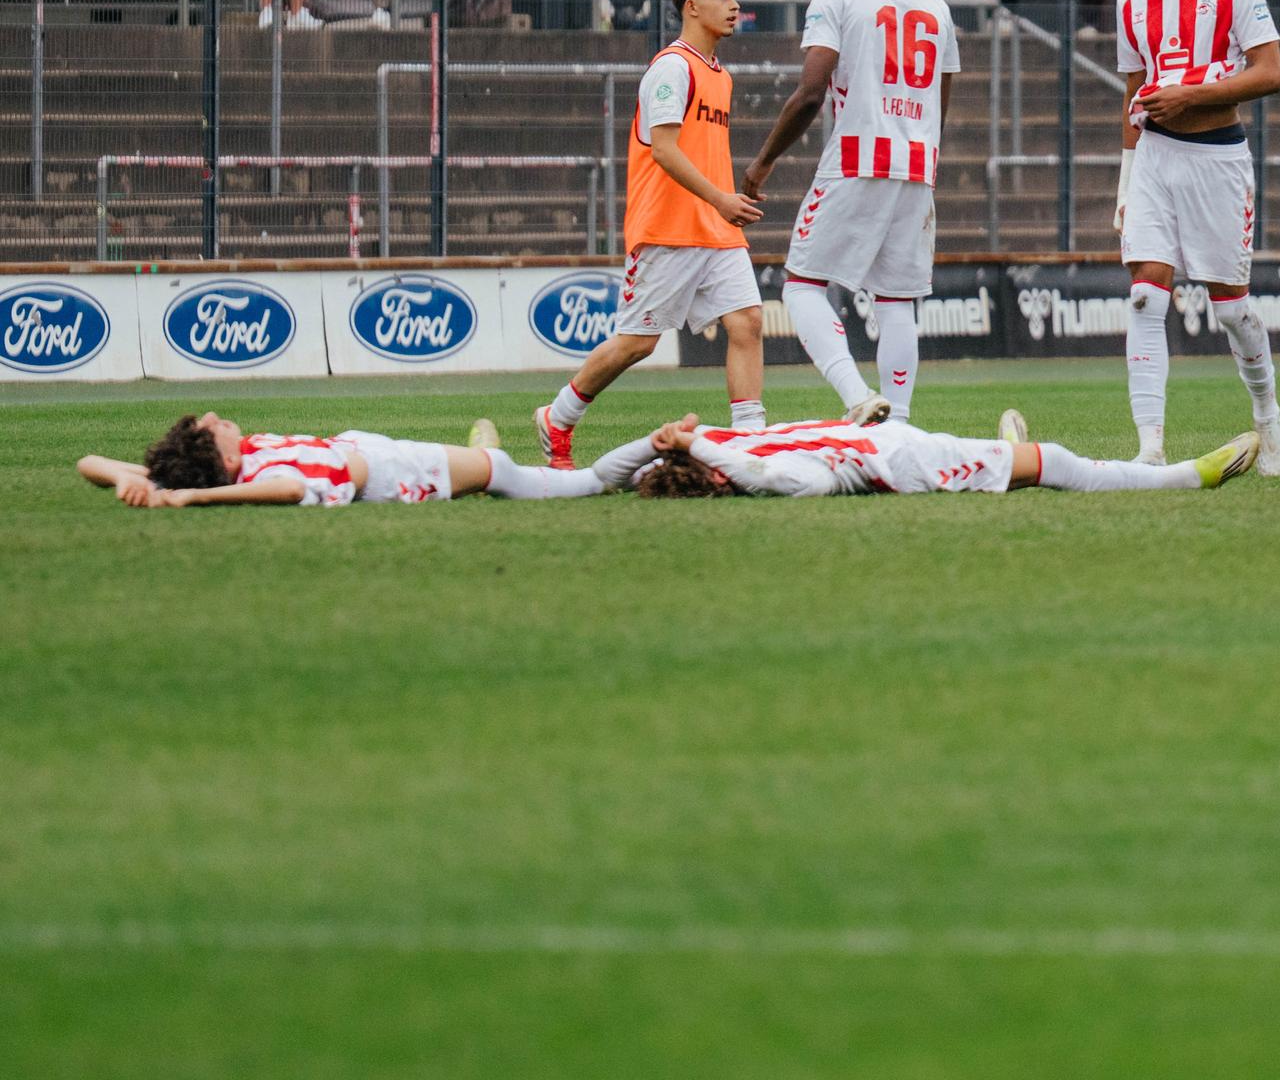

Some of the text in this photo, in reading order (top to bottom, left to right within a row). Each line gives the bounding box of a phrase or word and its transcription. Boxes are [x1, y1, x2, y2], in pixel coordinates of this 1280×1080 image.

[876, 5, 939, 88] 16
[891, 98, 903, 116] FC
[3, 296, 84, 357] Ford
[190, 294, 271, 353] Ford
[375, 288, 453, 347] Ford
[1051, 288, 1131, 338] humm
